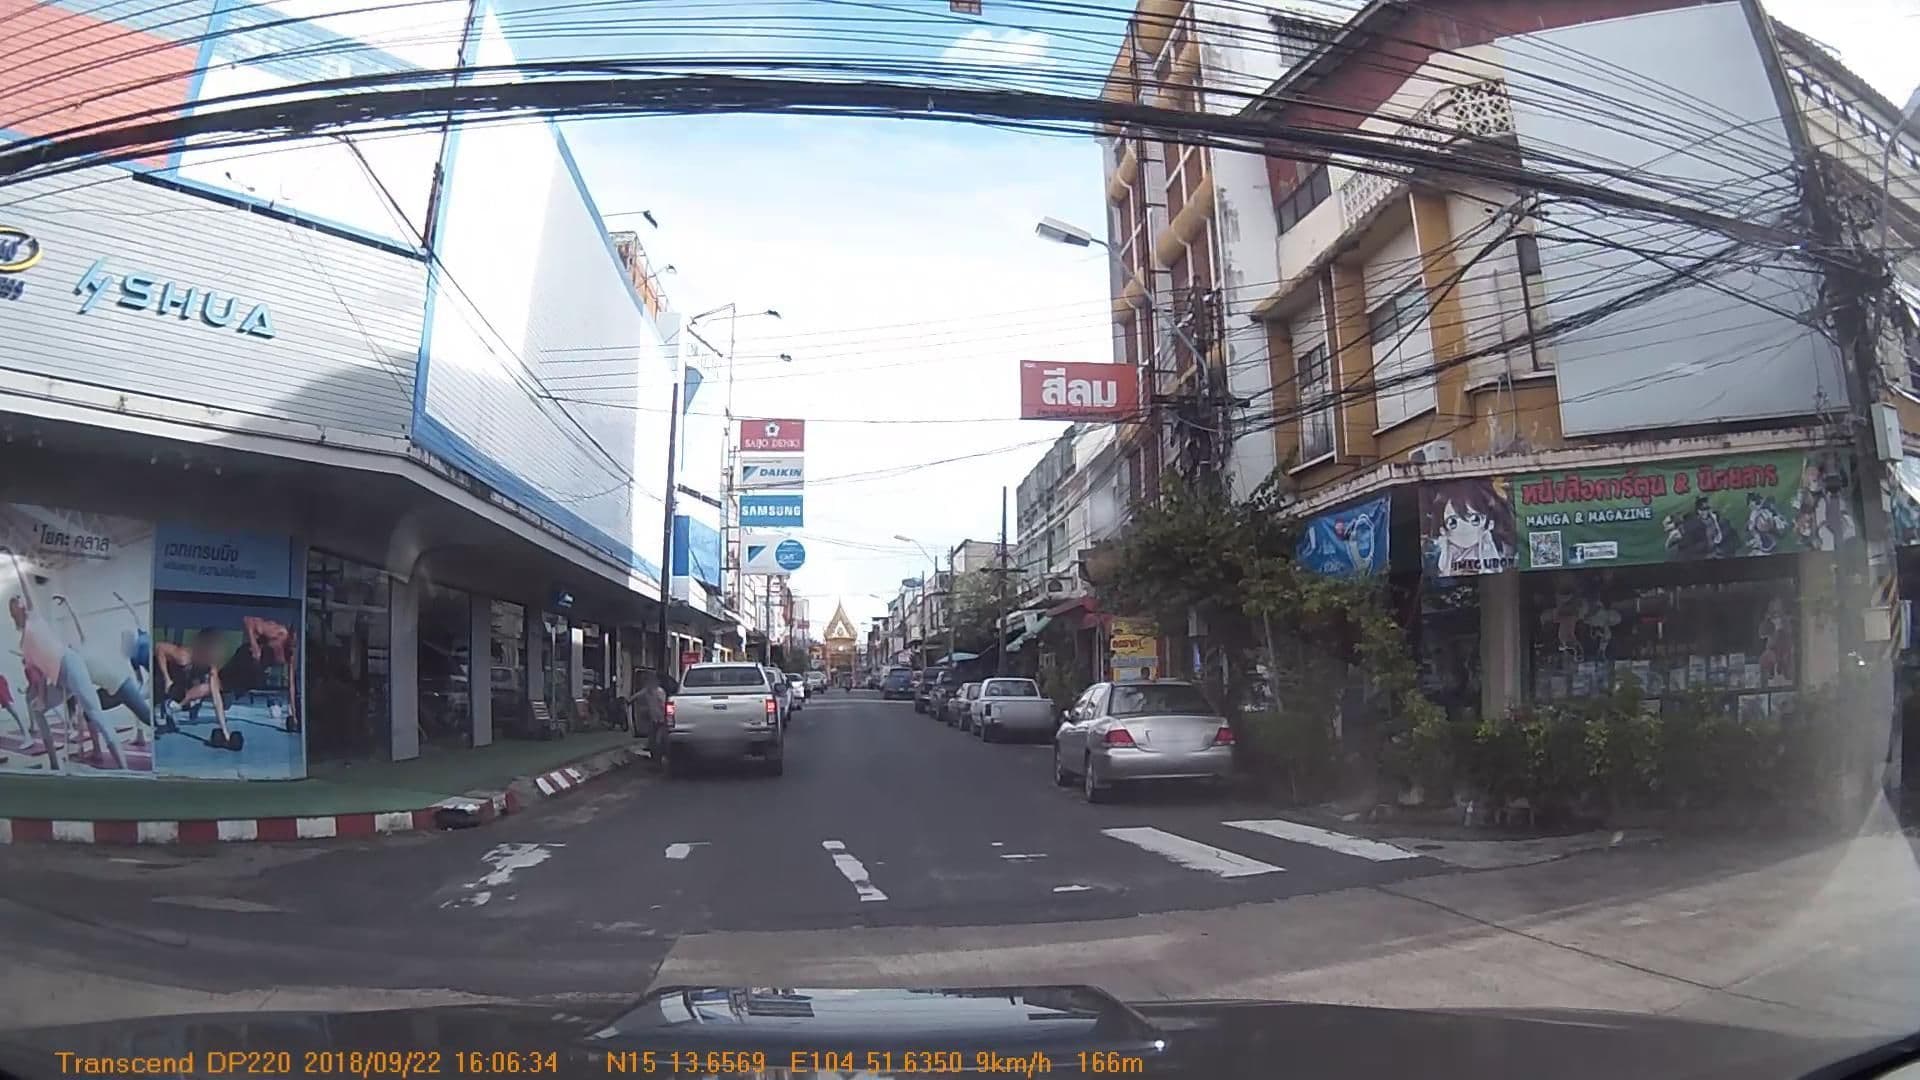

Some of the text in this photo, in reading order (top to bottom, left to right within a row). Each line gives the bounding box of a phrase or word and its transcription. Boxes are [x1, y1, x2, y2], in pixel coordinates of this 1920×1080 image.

[116, 270, 276, 339] SHUA
[1041, 367, 1117, 408] สีลม
[759, 468, 802, 477] DAIKIN
[1674, 472, 1690, 494] &
[1696, 464, 1778, 492] นิตยสาร
[741, 505, 801, 517] SAMSUNG
[1526, 507, 1652, 527] MANGA & MAGAZINE
